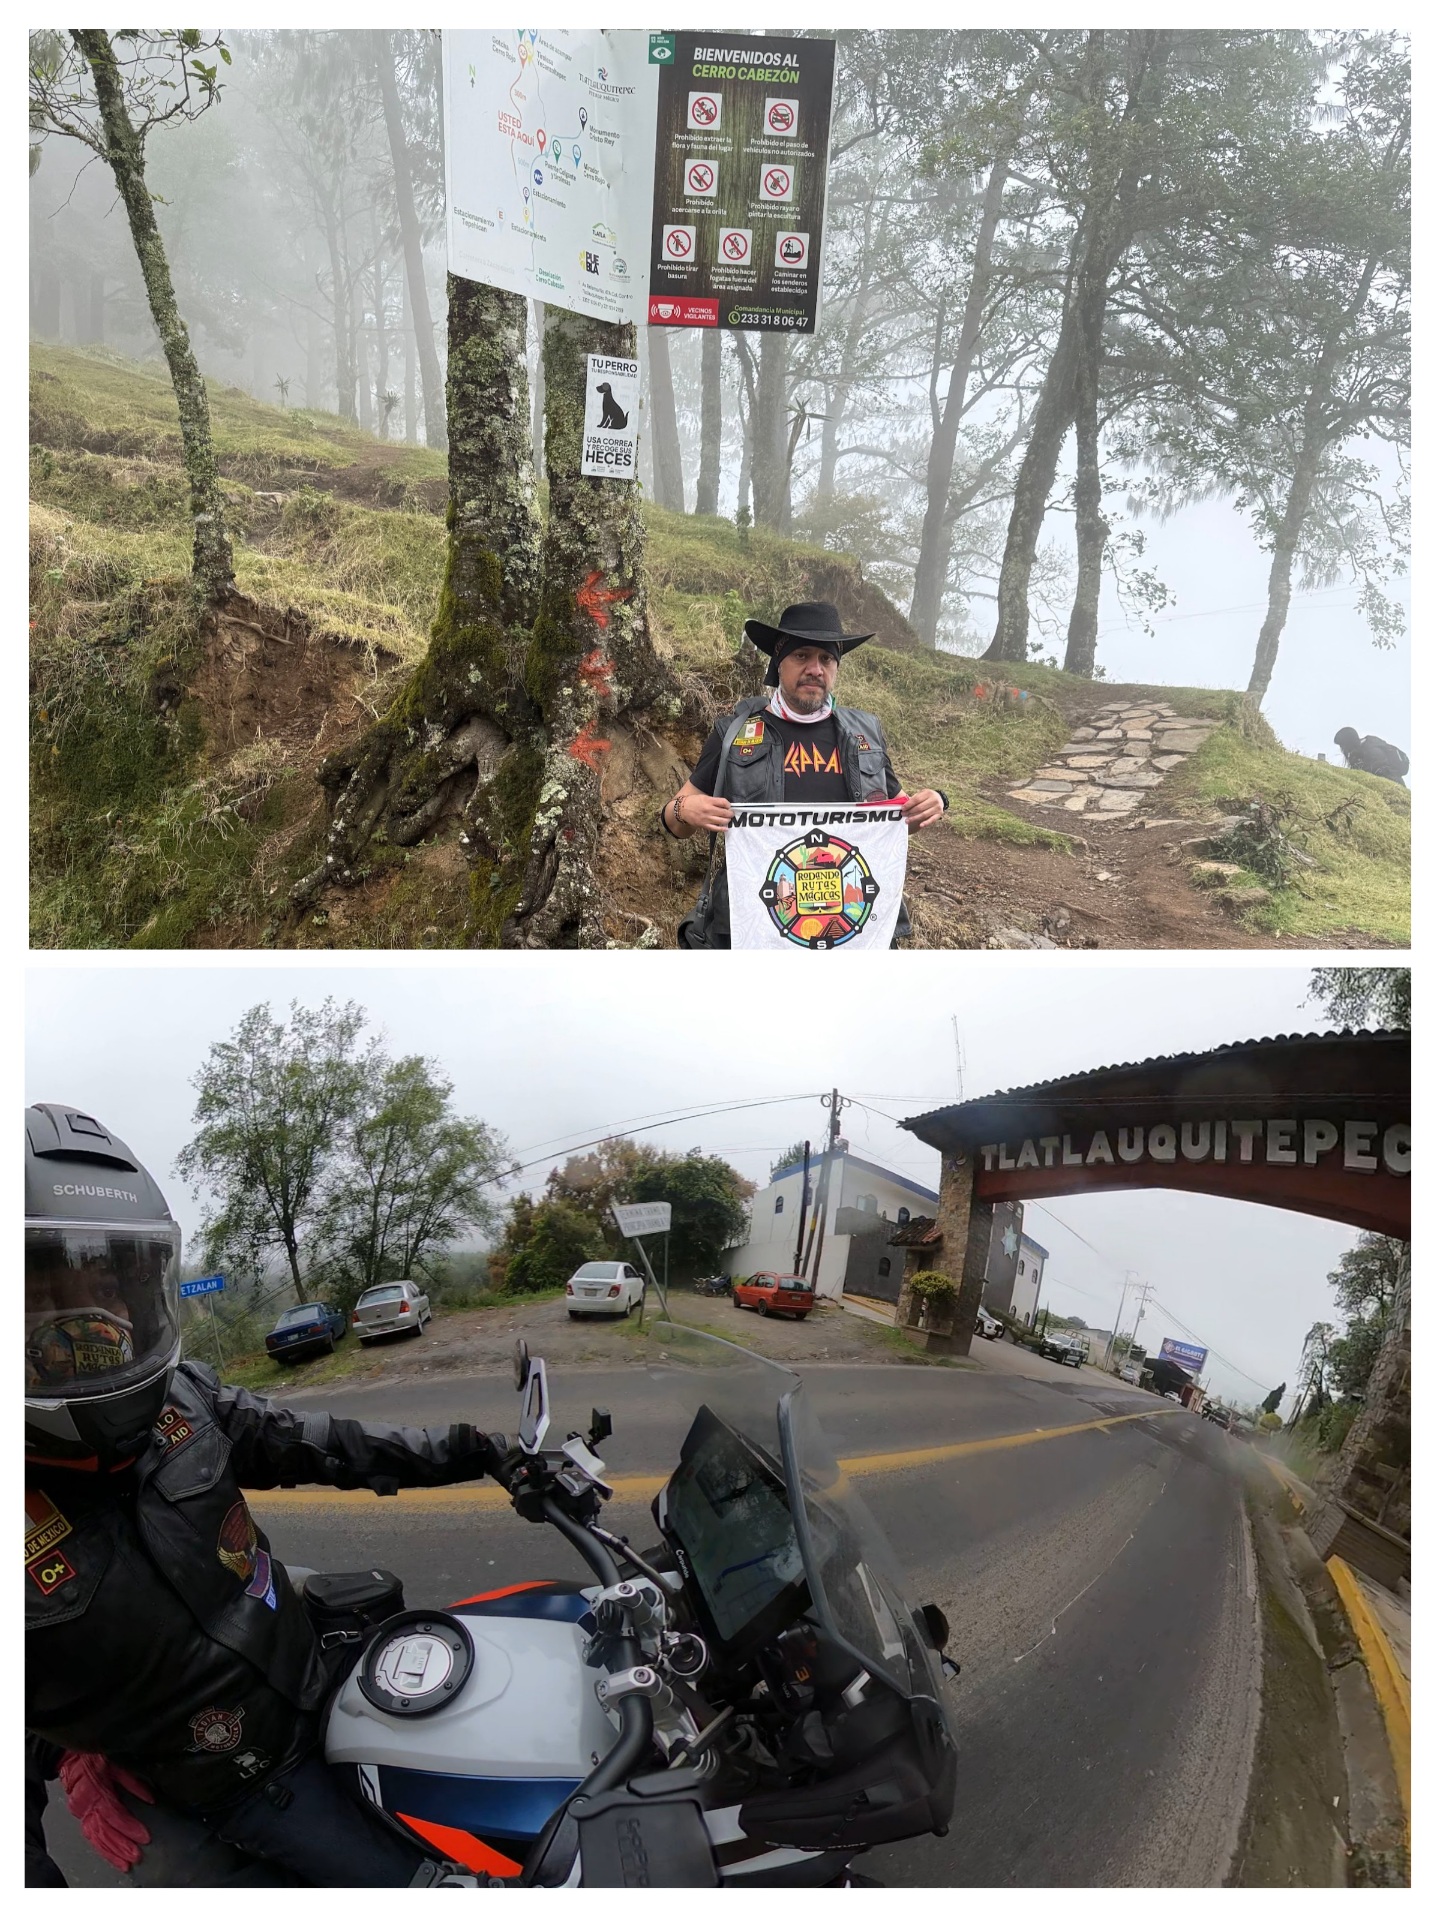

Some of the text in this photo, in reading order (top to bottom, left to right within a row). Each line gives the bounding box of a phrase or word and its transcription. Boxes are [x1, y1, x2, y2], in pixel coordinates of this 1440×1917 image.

[694, 47, 800, 67] BIENVENIDOS AL
[469, 64, 476, 77] N
[692, 64, 800, 84] CERRO CABEZÓN
[498, 110, 522, 129] USTED
[498, 122, 516, 139] ESTA
[589, 124, 621, 139] Monumento
[674, 133, 703, 142] Prohibido
[703, 135, 726, 143] extraer
[750, 138, 779, 147] Prohibido
[785, 141, 800, 149] paso
[671, 141, 686, 149] flora
[690, 142, 708, 150] fauna
[718, 144, 734, 152] lugar
[780, 148, 815, 158] autorizados
[685, 199, 714, 207] Prohibido
[750, 202, 779, 211] Prohibido
[779, 204, 794, 212] rayar
[671, 206, 701, 214] acercarse
[711, 208, 727, 216] orilla
[748, 211, 766, 219] pintar
[773, 212, 801, 220] escultura
[657, 264, 685, 272] Prohibido
[711, 266, 756, 276] Prohibido hacer
[667, 272, 687, 280] basura
[709, 274, 731, 283] fogatas
[749, 276, 757, 284] del
[774, 270, 798, 279] Caminar
[726, 283, 753, 292] asignada
[780, 279, 808, 287] senderos
[770, 286, 808, 294] establecidos
[735, 304, 805, 316] Comandancia Municipal
[683, 312, 716, 321] VIGILANTES
[741, 313, 759, 325] 233
[781, 315, 795, 326] 06
[796, 316, 809, 327] 47
[592, 358, 638, 373] TU PERRO
[597, 368, 637, 379] RESPONSABILIDAD
[587, 436, 633, 448] USA CORREA
[592, 444, 619, 453] RECOGE
[620, 446, 632, 455] SUS
[585, 450, 632, 467] HECES
[728, 809, 903, 829] MOTOTURISMO
[811, 834, 823, 843] N
[798, 871, 840, 881] RODANDO
[802, 880, 837, 892] RUTAS
[866, 884, 876, 894] E
[763, 889, 774, 898] O
[817, 941, 827, 949] S
[980, 1118, 1411, 1177] TLATLAUQUITEPEC
[52, 1184, 138, 1203] SCHUBERTH
[27, 1540, 40, 1554] DE
[37, 1522, 66, 1547] MEXICO
[41, 1562, 65, 1584] O+
[197, 1713, 223, 1737] INDIAN
